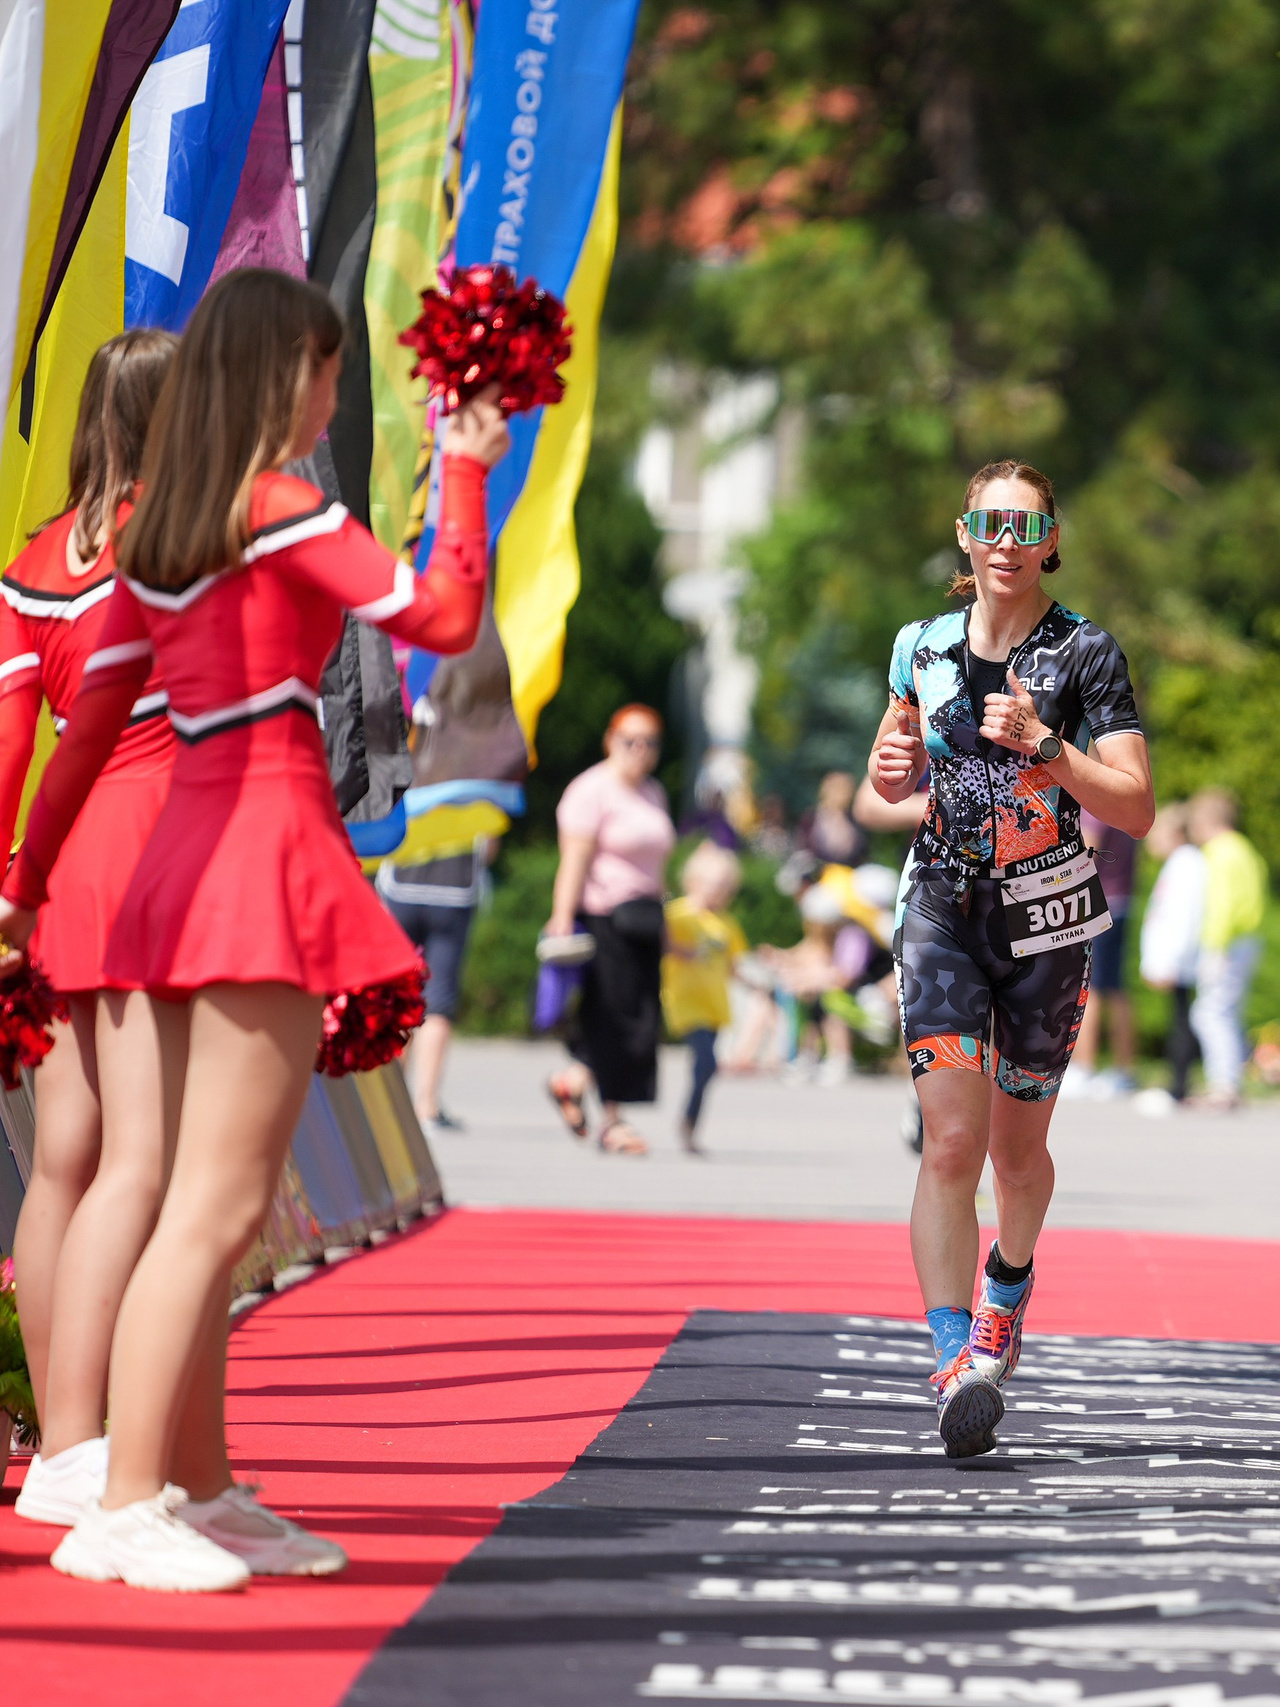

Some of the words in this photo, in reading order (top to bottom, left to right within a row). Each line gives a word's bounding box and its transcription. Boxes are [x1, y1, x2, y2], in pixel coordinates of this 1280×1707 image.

[490, 49, 547, 272] ТРАХОВОЙ
[525, 0, 560, 45] Д
[1010, 707, 1030, 742] 3077
[1016, 841, 1079, 875] NUTREND
[1041, 875, 1055, 886] IRON
[1060, 869, 1073, 880] STAR
[1026, 887, 1092, 933] 3077
[1050, 928, 1086, 944] TATYANA
[822, 1389, 1084, 1411] IRN
